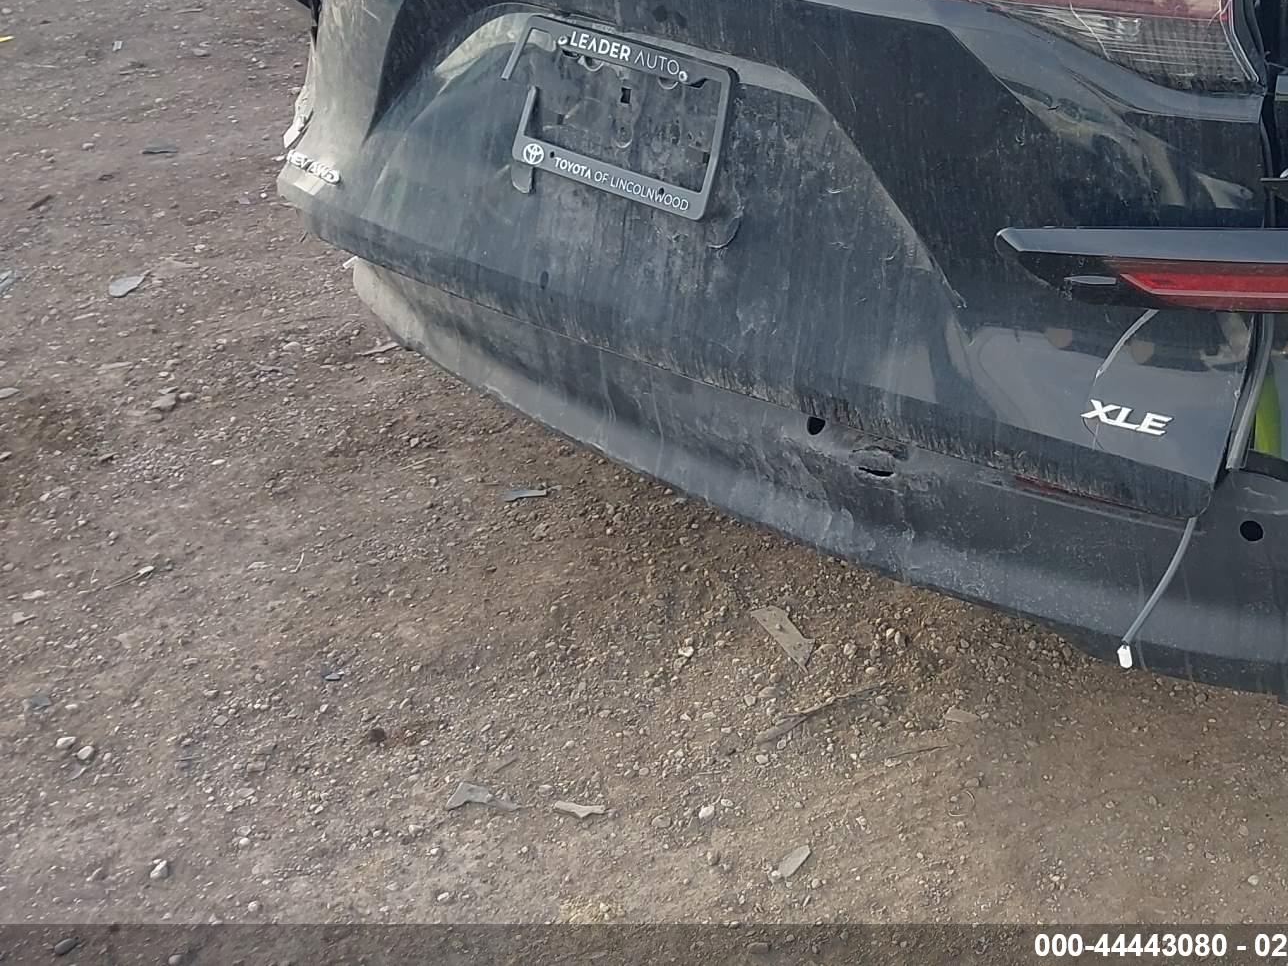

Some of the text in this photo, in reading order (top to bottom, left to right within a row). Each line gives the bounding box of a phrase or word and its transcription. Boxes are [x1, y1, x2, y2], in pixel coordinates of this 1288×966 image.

[569, 31, 680, 76] LEADER AUTO
[553, 156, 689, 212] TOYOTA OF LINCOLNWOOD
[1080, 399, 1174, 435] XLE
